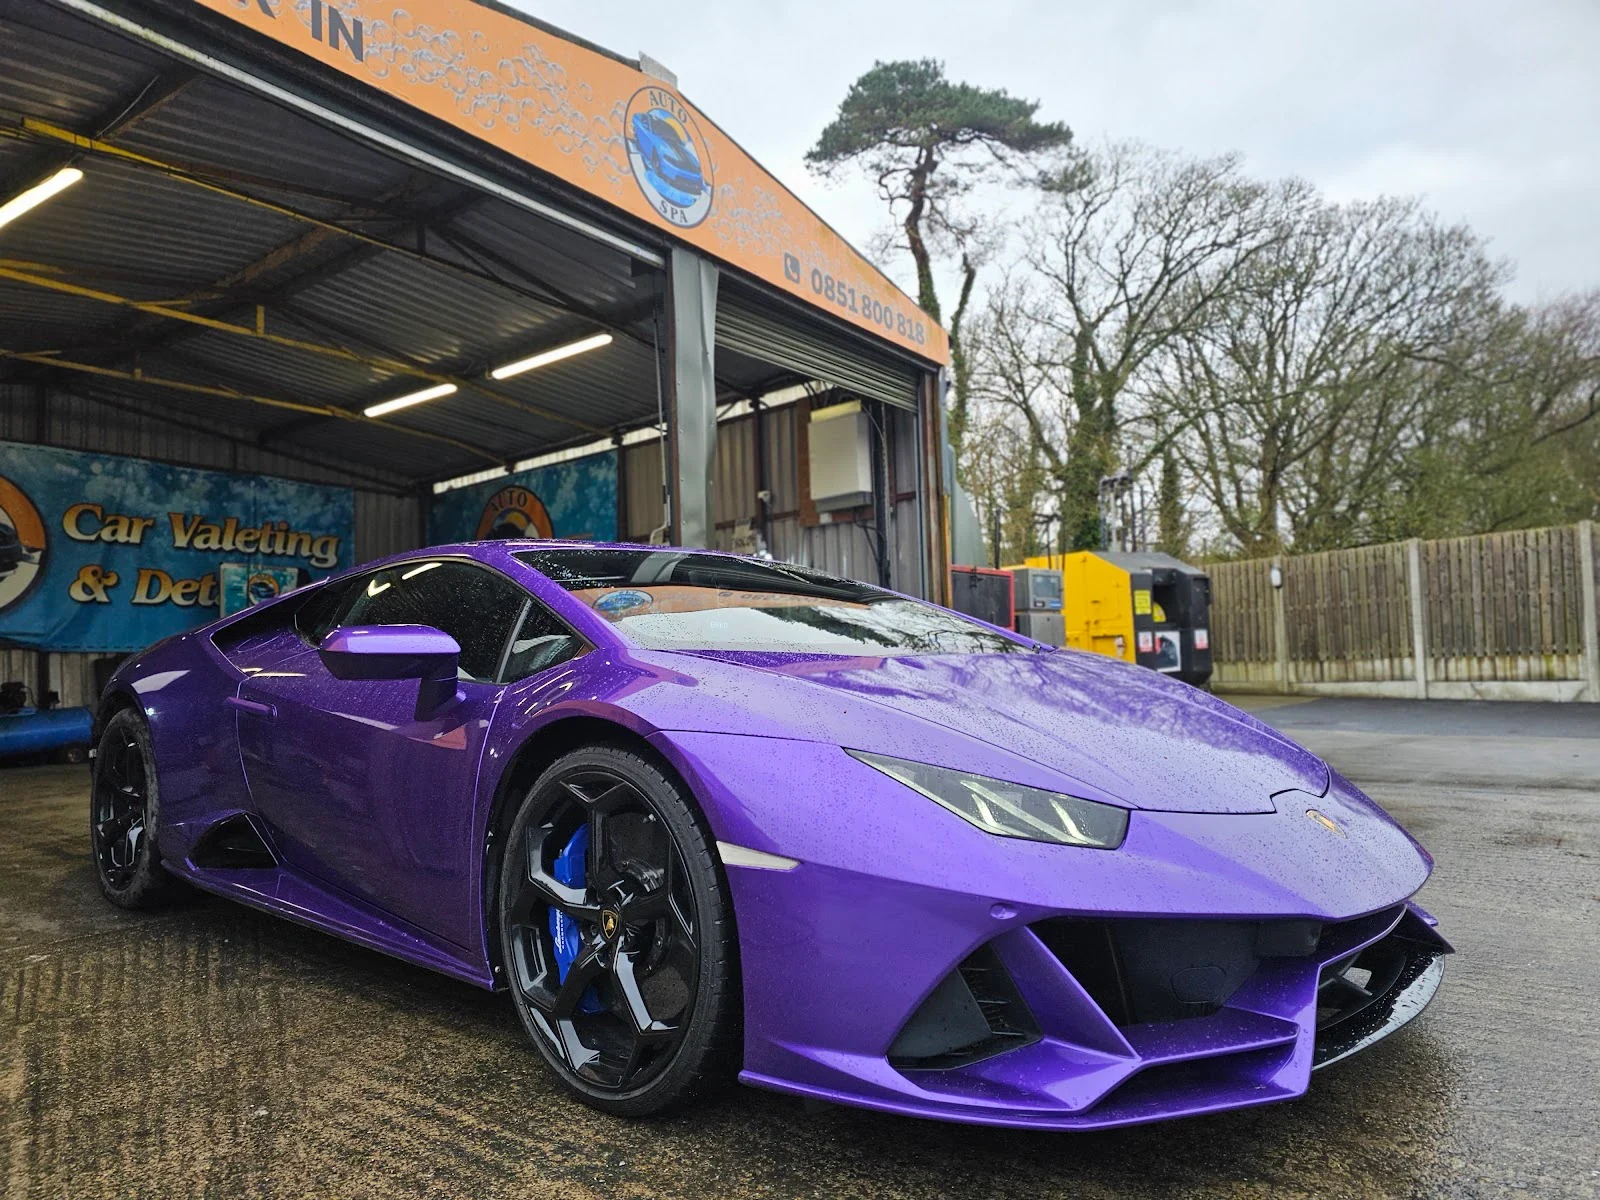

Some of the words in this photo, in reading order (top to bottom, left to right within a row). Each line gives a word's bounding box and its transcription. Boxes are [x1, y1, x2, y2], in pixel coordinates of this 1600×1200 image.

[311, 0, 364, 62] IN
[648, 89, 688, 124] AUTO
[659, 200, 689, 224] SPA
[811, 267, 859, 314] 0851
[862, 295, 894, 330] 800
[897, 312, 925, 345] 818
[490, 490, 528, 513] AUTO
[61, 502, 154, 544] Car
[167, 511, 340, 569] Valeting
[68, 563, 120, 604] &
